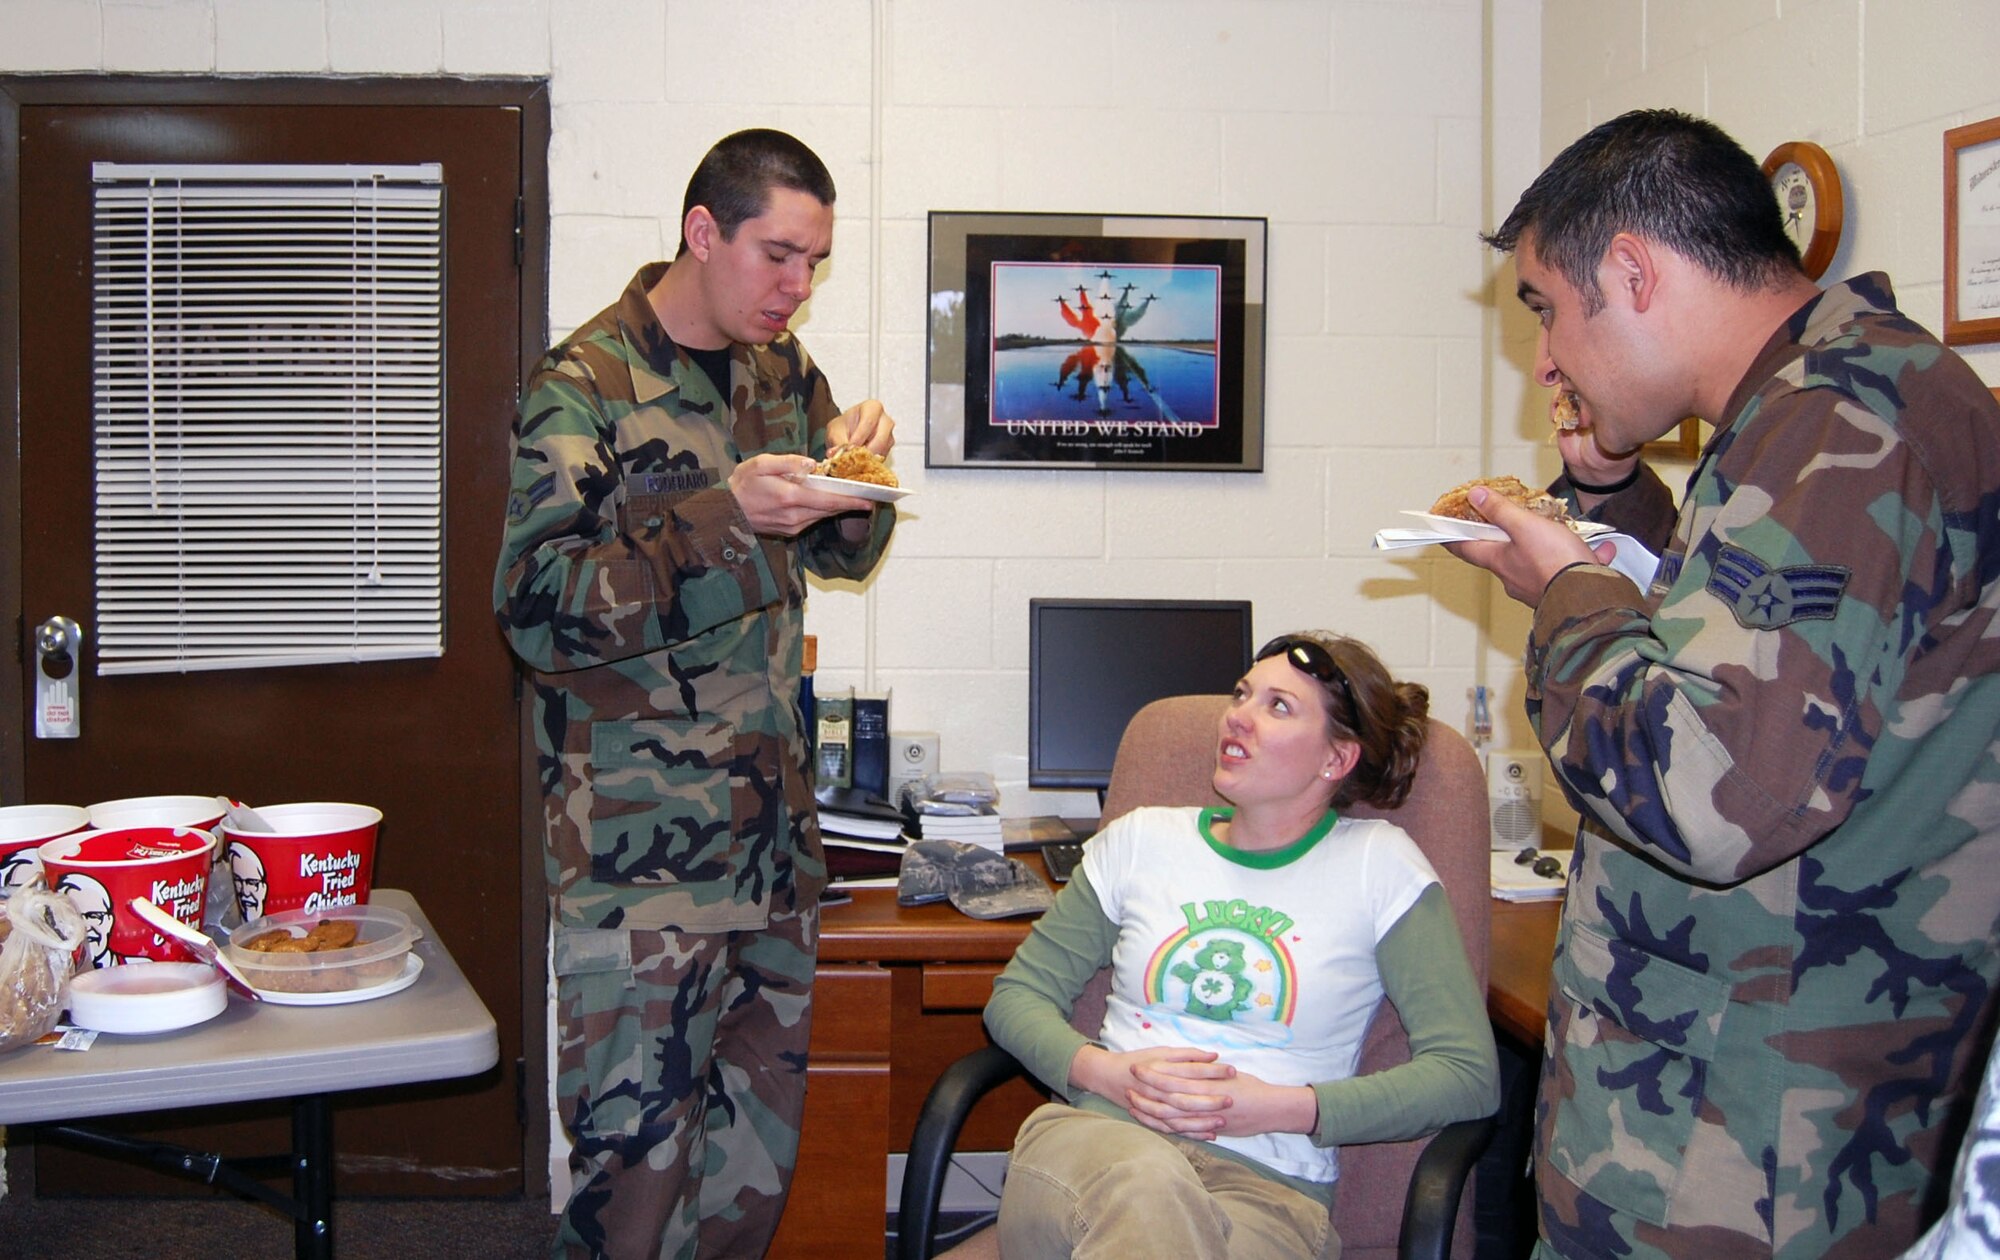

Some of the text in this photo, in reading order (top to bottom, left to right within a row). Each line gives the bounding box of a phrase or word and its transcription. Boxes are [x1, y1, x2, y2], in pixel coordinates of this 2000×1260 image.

[1006, 419, 1204, 438] UNITED WE STAND
[300, 849, 360, 878] Kentucky
[151, 873, 205, 906] Kentucky
[322, 867, 356, 896] Fried
[173, 892, 201, 921] Fried
[303, 889, 357, 916] Chicken
[1180, 898, 1295, 944] LUCKY!
